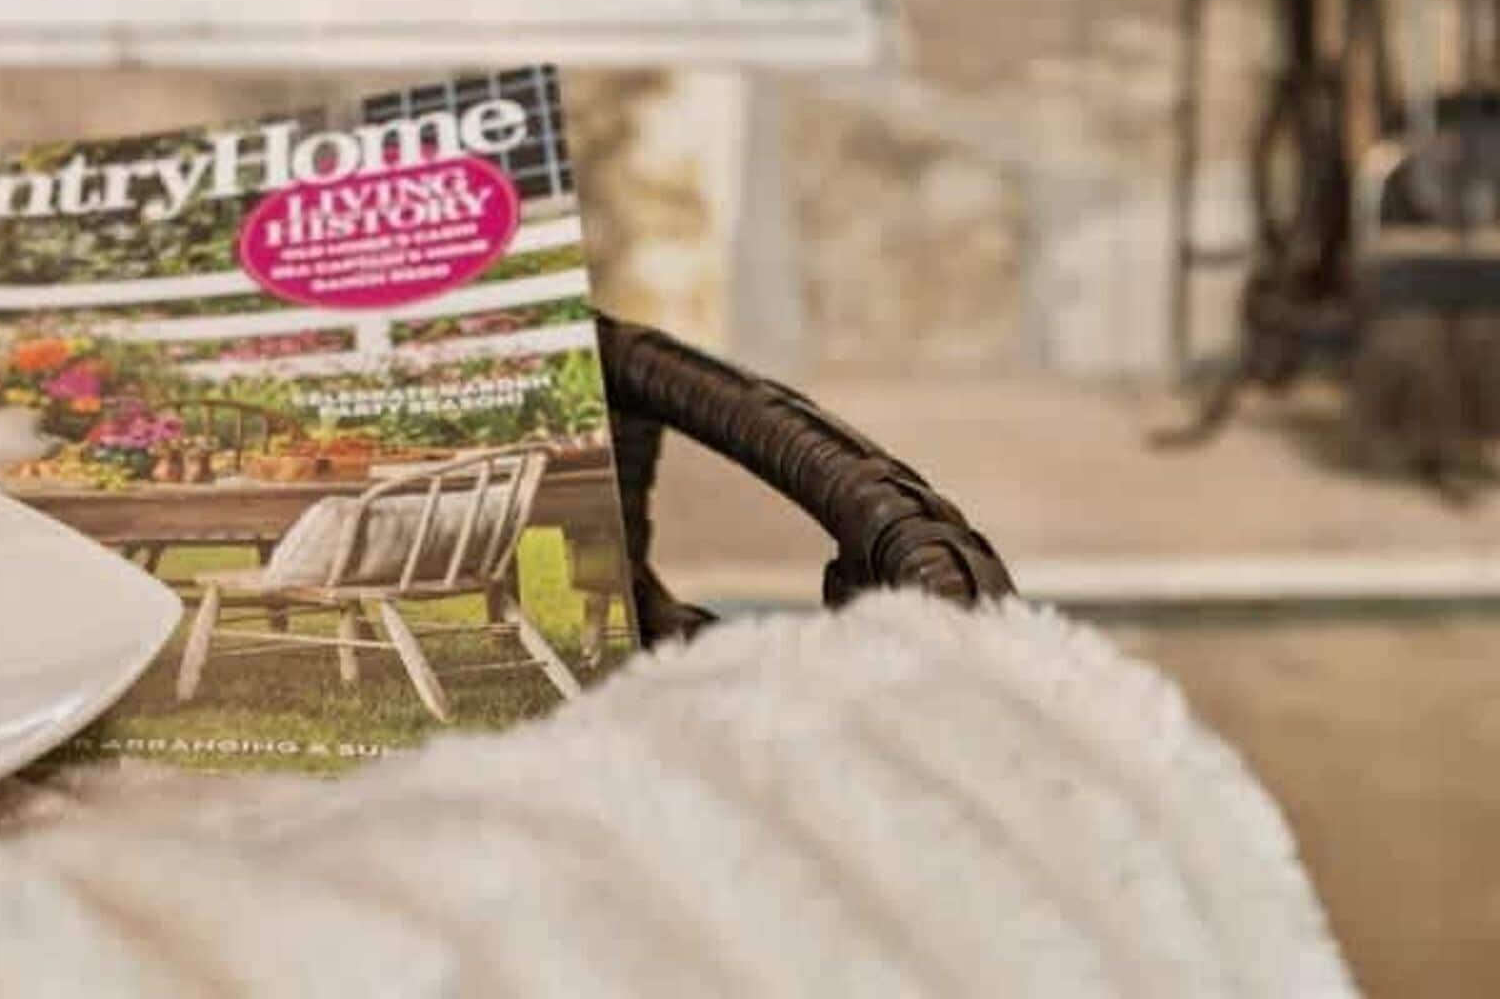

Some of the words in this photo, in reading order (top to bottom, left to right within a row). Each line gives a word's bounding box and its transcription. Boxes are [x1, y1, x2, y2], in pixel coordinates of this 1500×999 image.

[264, 188, 494, 247] HISTORY
[286, 167, 470, 223] LIVING
[100, 736, 301, 755] ARRANGING
